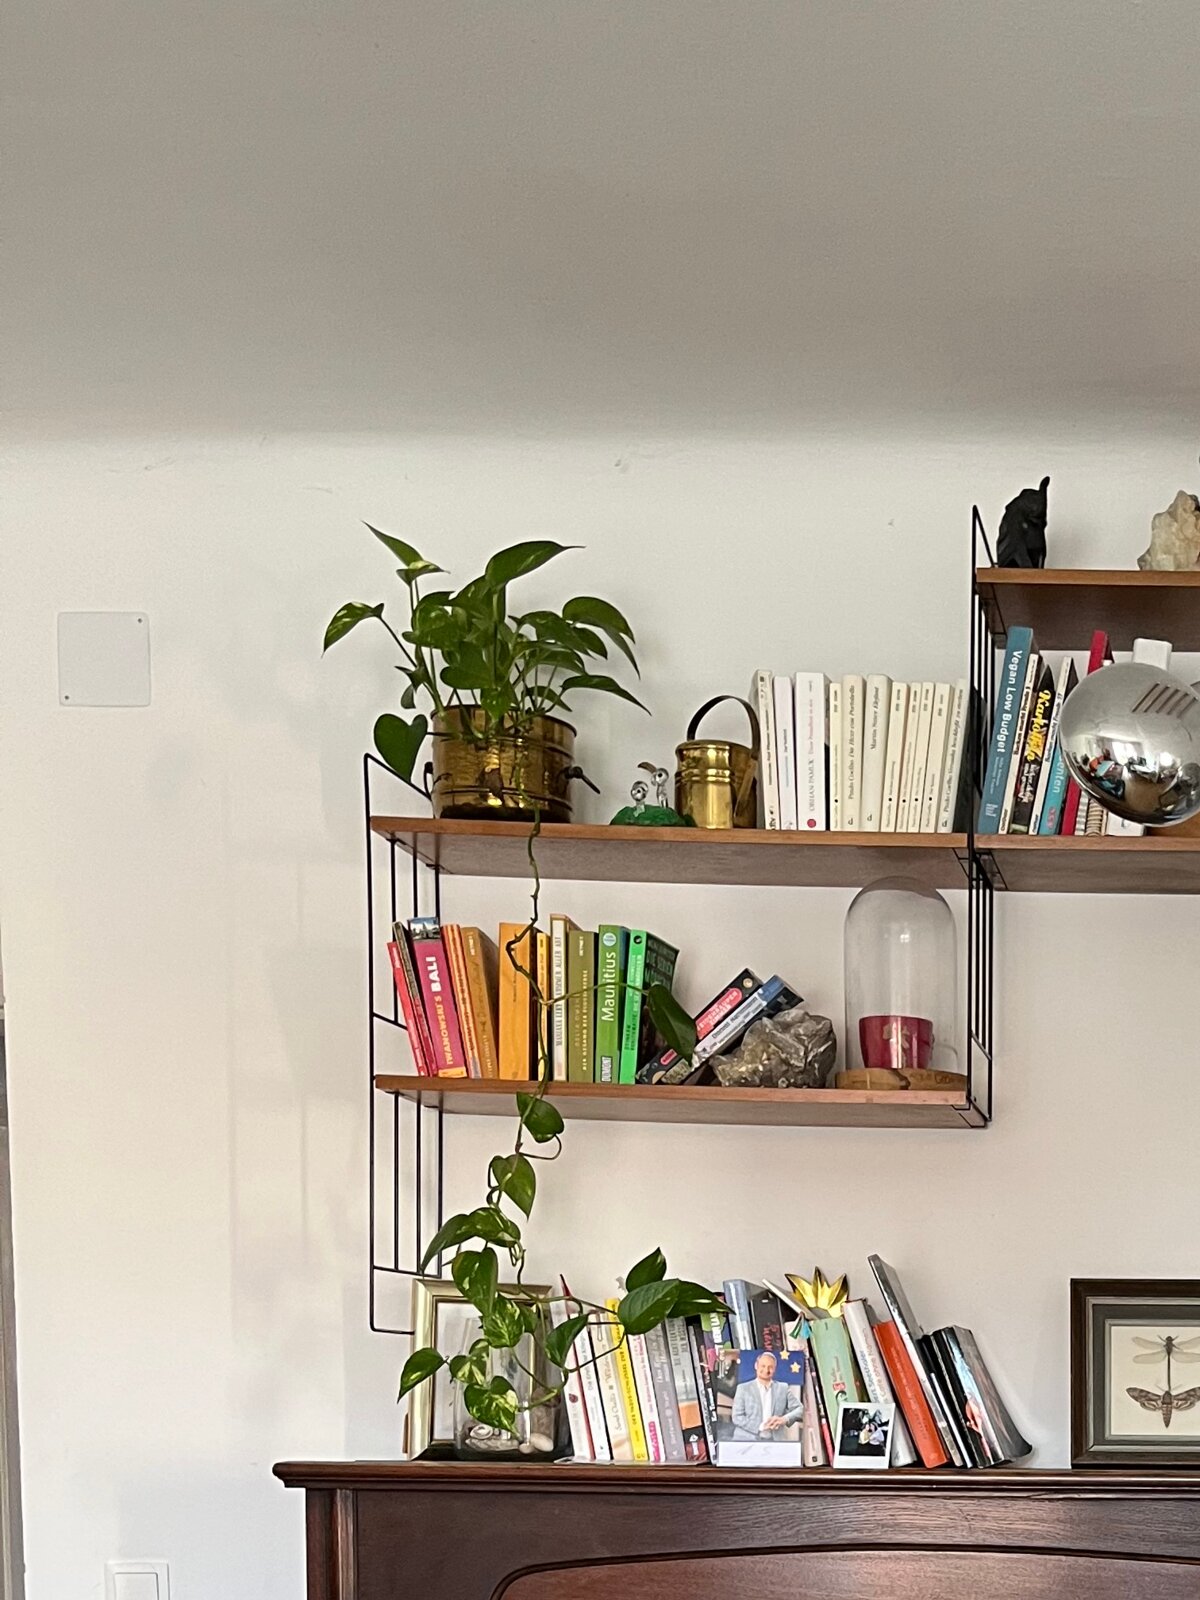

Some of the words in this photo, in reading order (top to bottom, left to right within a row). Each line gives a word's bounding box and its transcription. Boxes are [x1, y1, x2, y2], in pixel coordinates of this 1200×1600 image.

[1007, 650, 1023, 684] Vegan
[1003, 687, 1017, 711] Low
[996, 713, 1011, 753] Budget
[425, 956, 442, 992] BALI
[601, 952, 617, 1021] Mauritius
